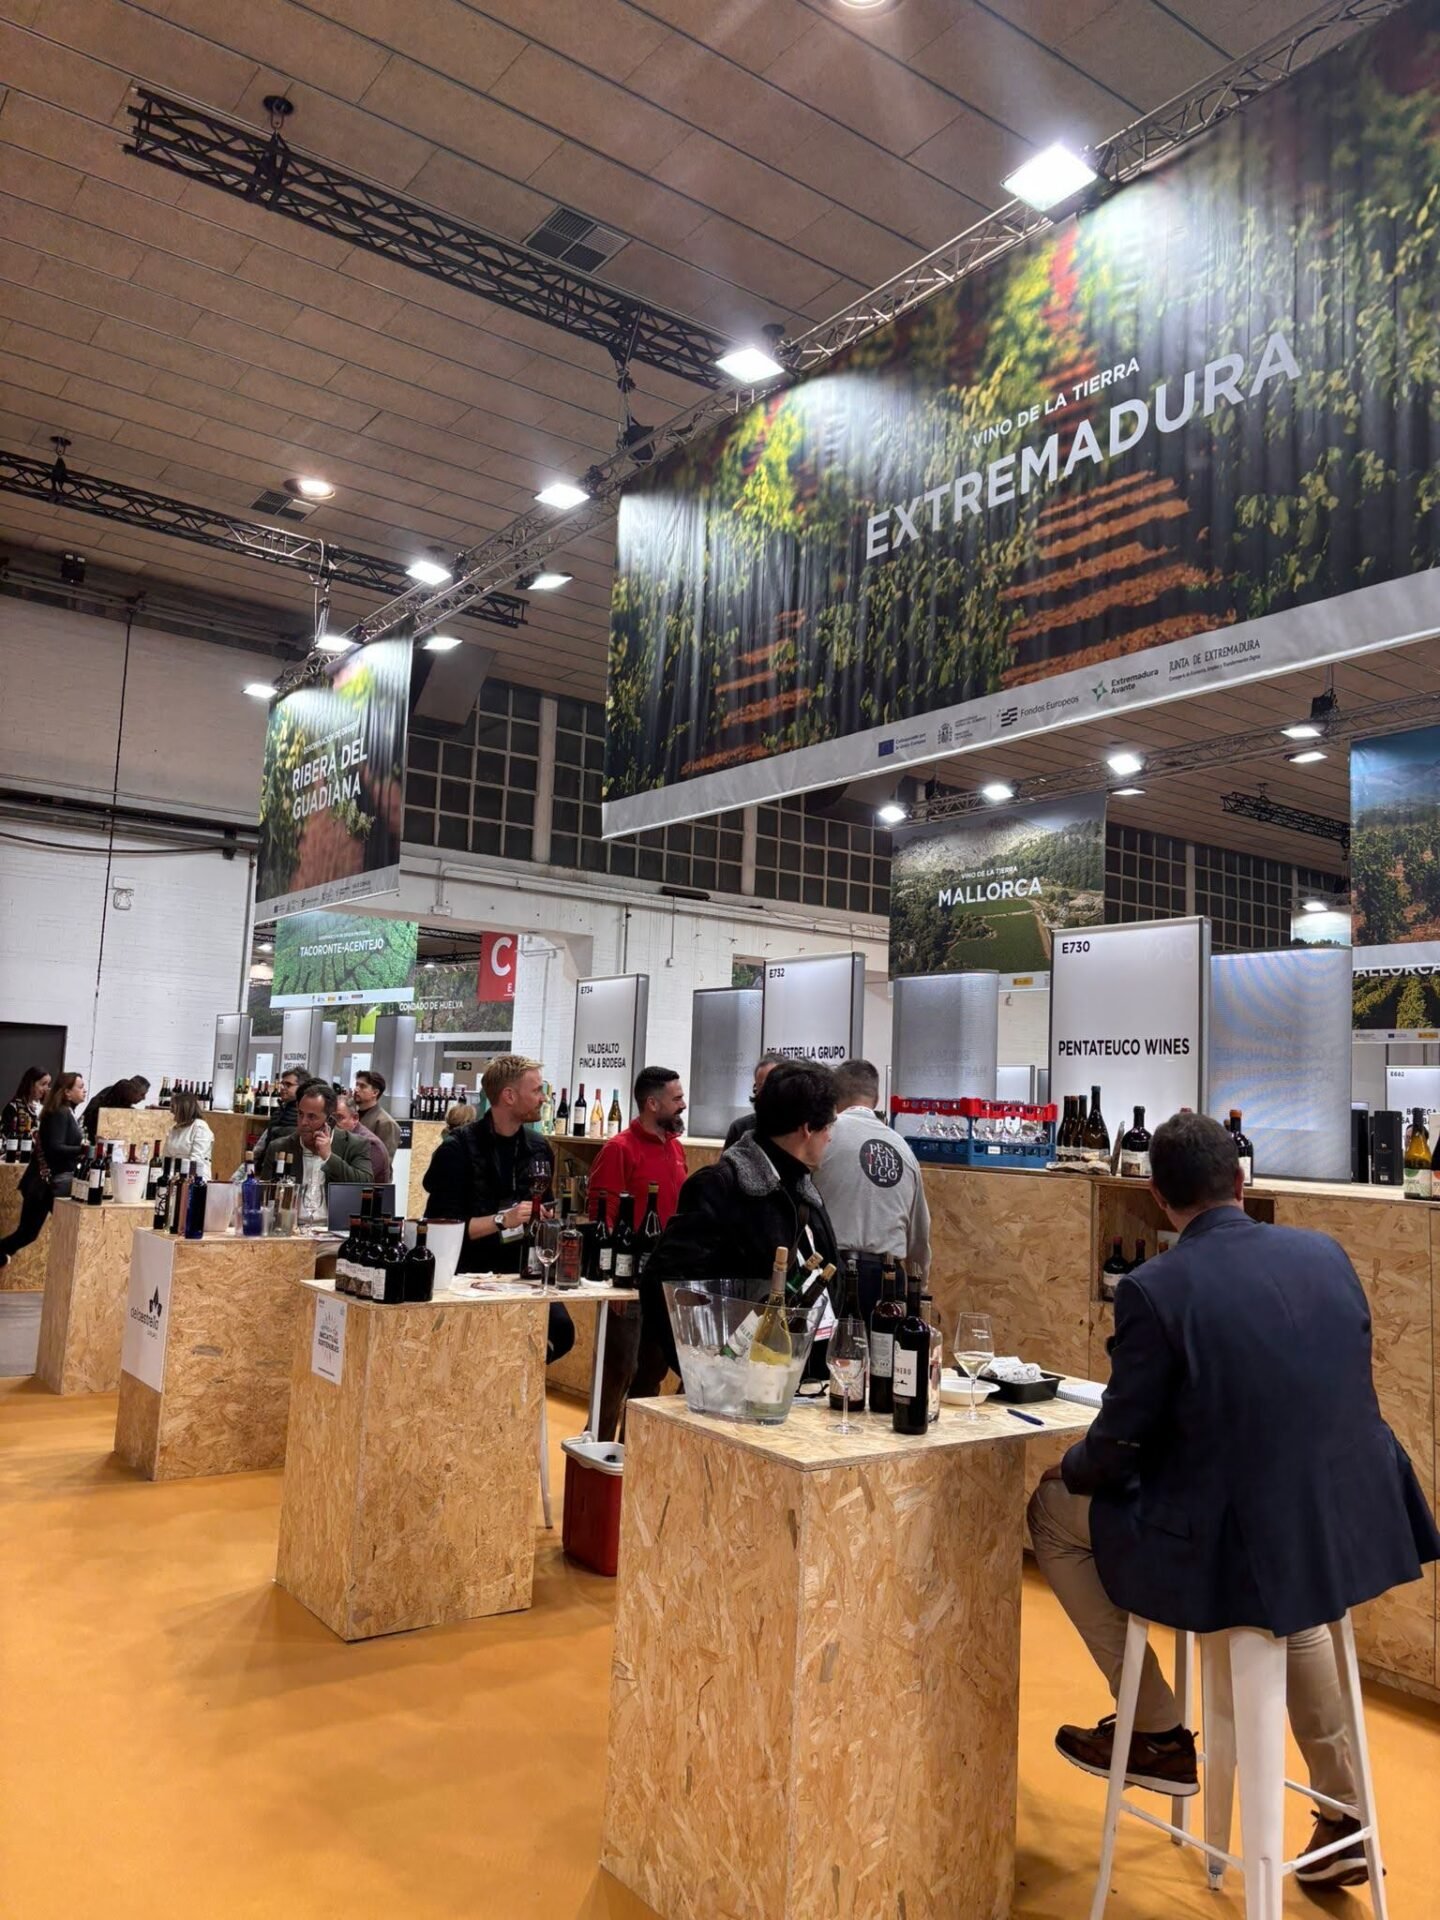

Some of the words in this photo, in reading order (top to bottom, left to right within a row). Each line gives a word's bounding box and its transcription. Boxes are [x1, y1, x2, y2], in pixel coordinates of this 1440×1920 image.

[972, 417, 1013, 449] VINO
[1017, 406, 1040, 430] DE
[1043, 393, 1068, 416] LA
[1072, 357, 1140, 403] TIERRA
[865, 331, 1302, 561] EXTREMADURA
[1168, 657, 1189, 673] JUNTA
[1193, 653, 1202, 664] DE
[1204, 639, 1261, 661] EXTREMADURA
[1111, 668, 1159, 687] Extremadura
[1110, 682, 1136, 695] Avante
[1020, 703, 1045, 718] Fondos
[1045, 695, 1080, 711] Europeos
[292, 750, 337, 791] RIBERA
[340, 737, 368, 770] DEL
[292, 771, 361, 820] GUADIANA
[961, 871, 976, 880] VINO
[977, 870, 986, 878] DE
[995, 865, 1018, 874] TIERRA
[938, 877, 1042, 907] MALLORCA
[300, 938, 384, 957] TACORONTE-ACENTEJO
[1062, 940, 1091, 954] E730
[491, 937, 513, 976] C
[769, 968, 785, 978] E732
[580, 985, 593, 994] E734
[430, 1001, 439, 1010] DE
[440, 1000, 464, 1010] HUELVA
[587, 1042, 620, 1054] VALDEALTO
[817, 1046, 845, 1059] GRUPO
[1058, 1039, 1140, 1056] PENTATEUCO
[1144, 1038, 1190, 1055] WINES
[579, 1058, 595, 1068] FINCA
[602, 1057, 626, 1068] BODEGA
[869, 1143, 894, 1157] PEN
[864, 1151, 899, 1170] TATE
[868, 1164, 898, 1180] UCO
